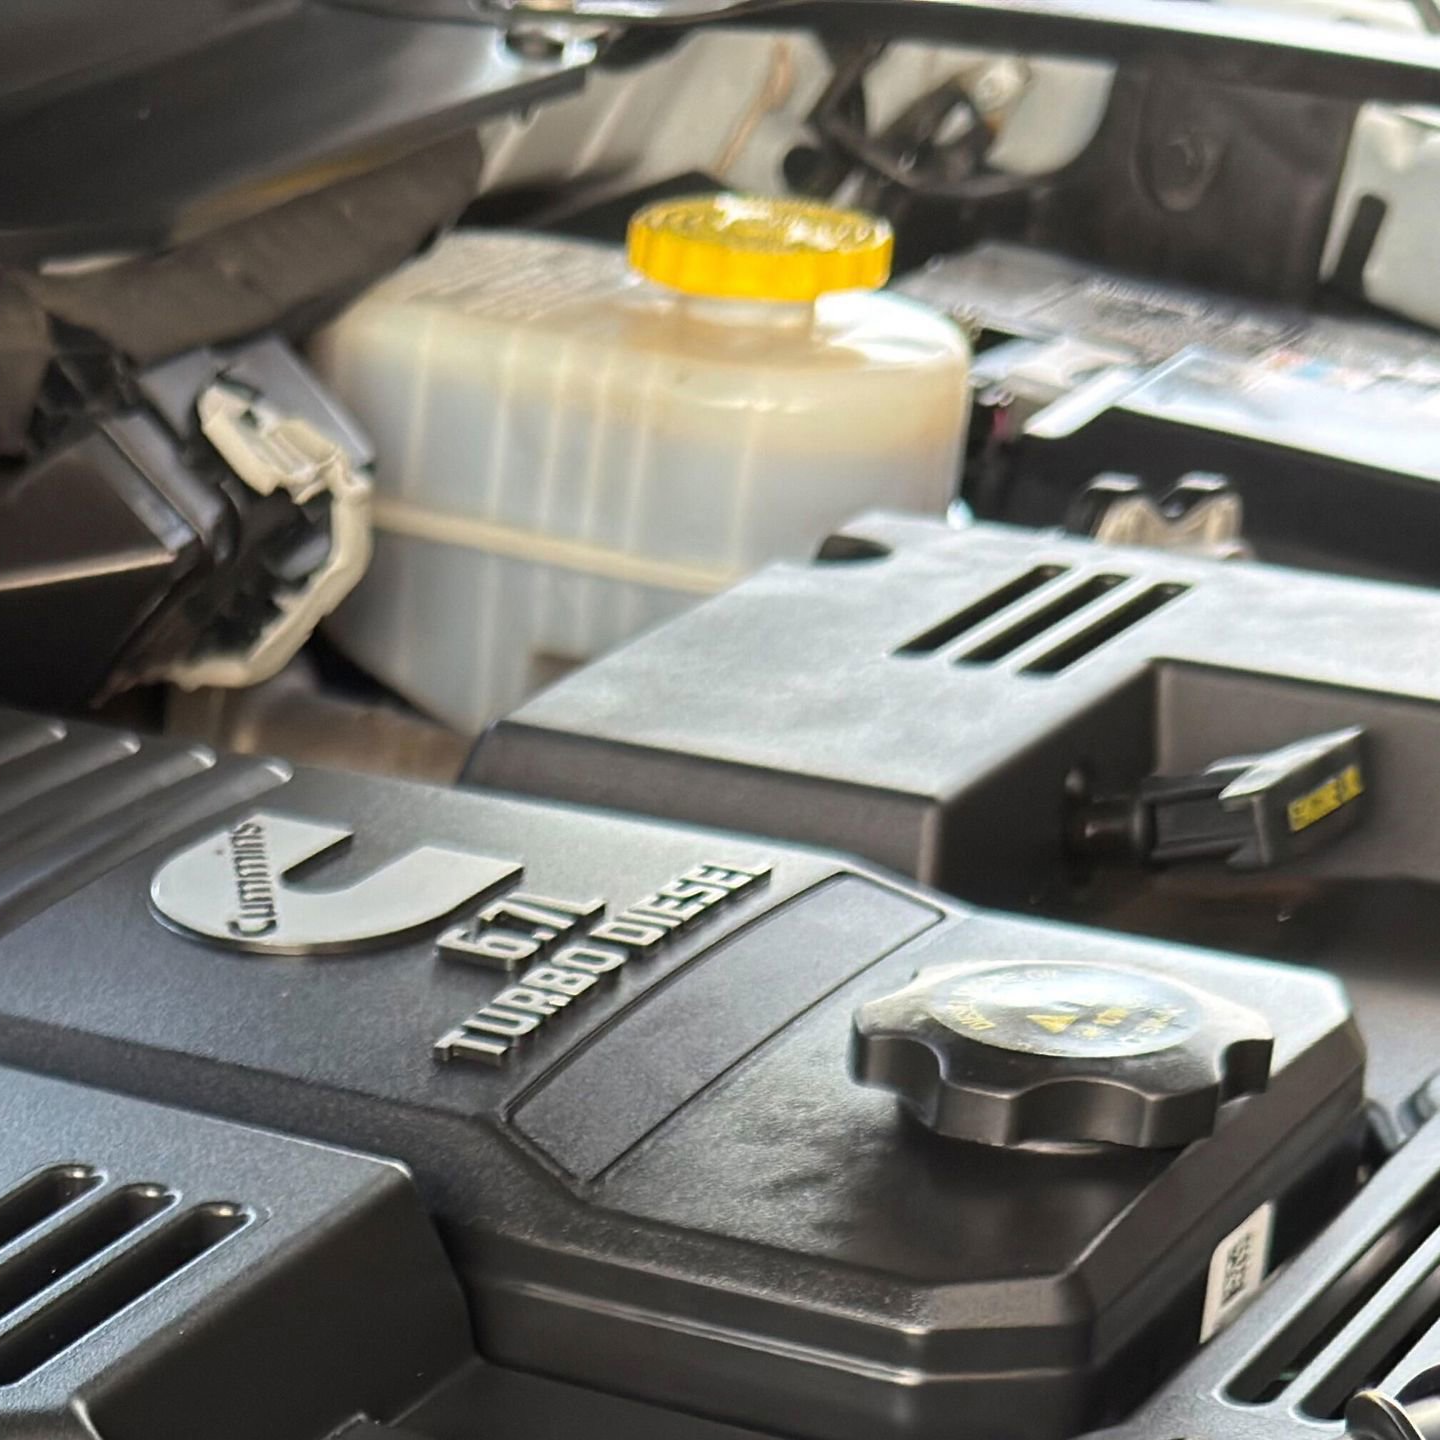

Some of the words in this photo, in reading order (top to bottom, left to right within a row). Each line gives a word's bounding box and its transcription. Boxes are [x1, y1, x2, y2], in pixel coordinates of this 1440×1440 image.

[228, 822, 280, 938] Cummins
[435, 890, 606, 971] 6.7L
[433, 944, 627, 1066] TURBO
[592, 862, 774, 954] DIESEL
